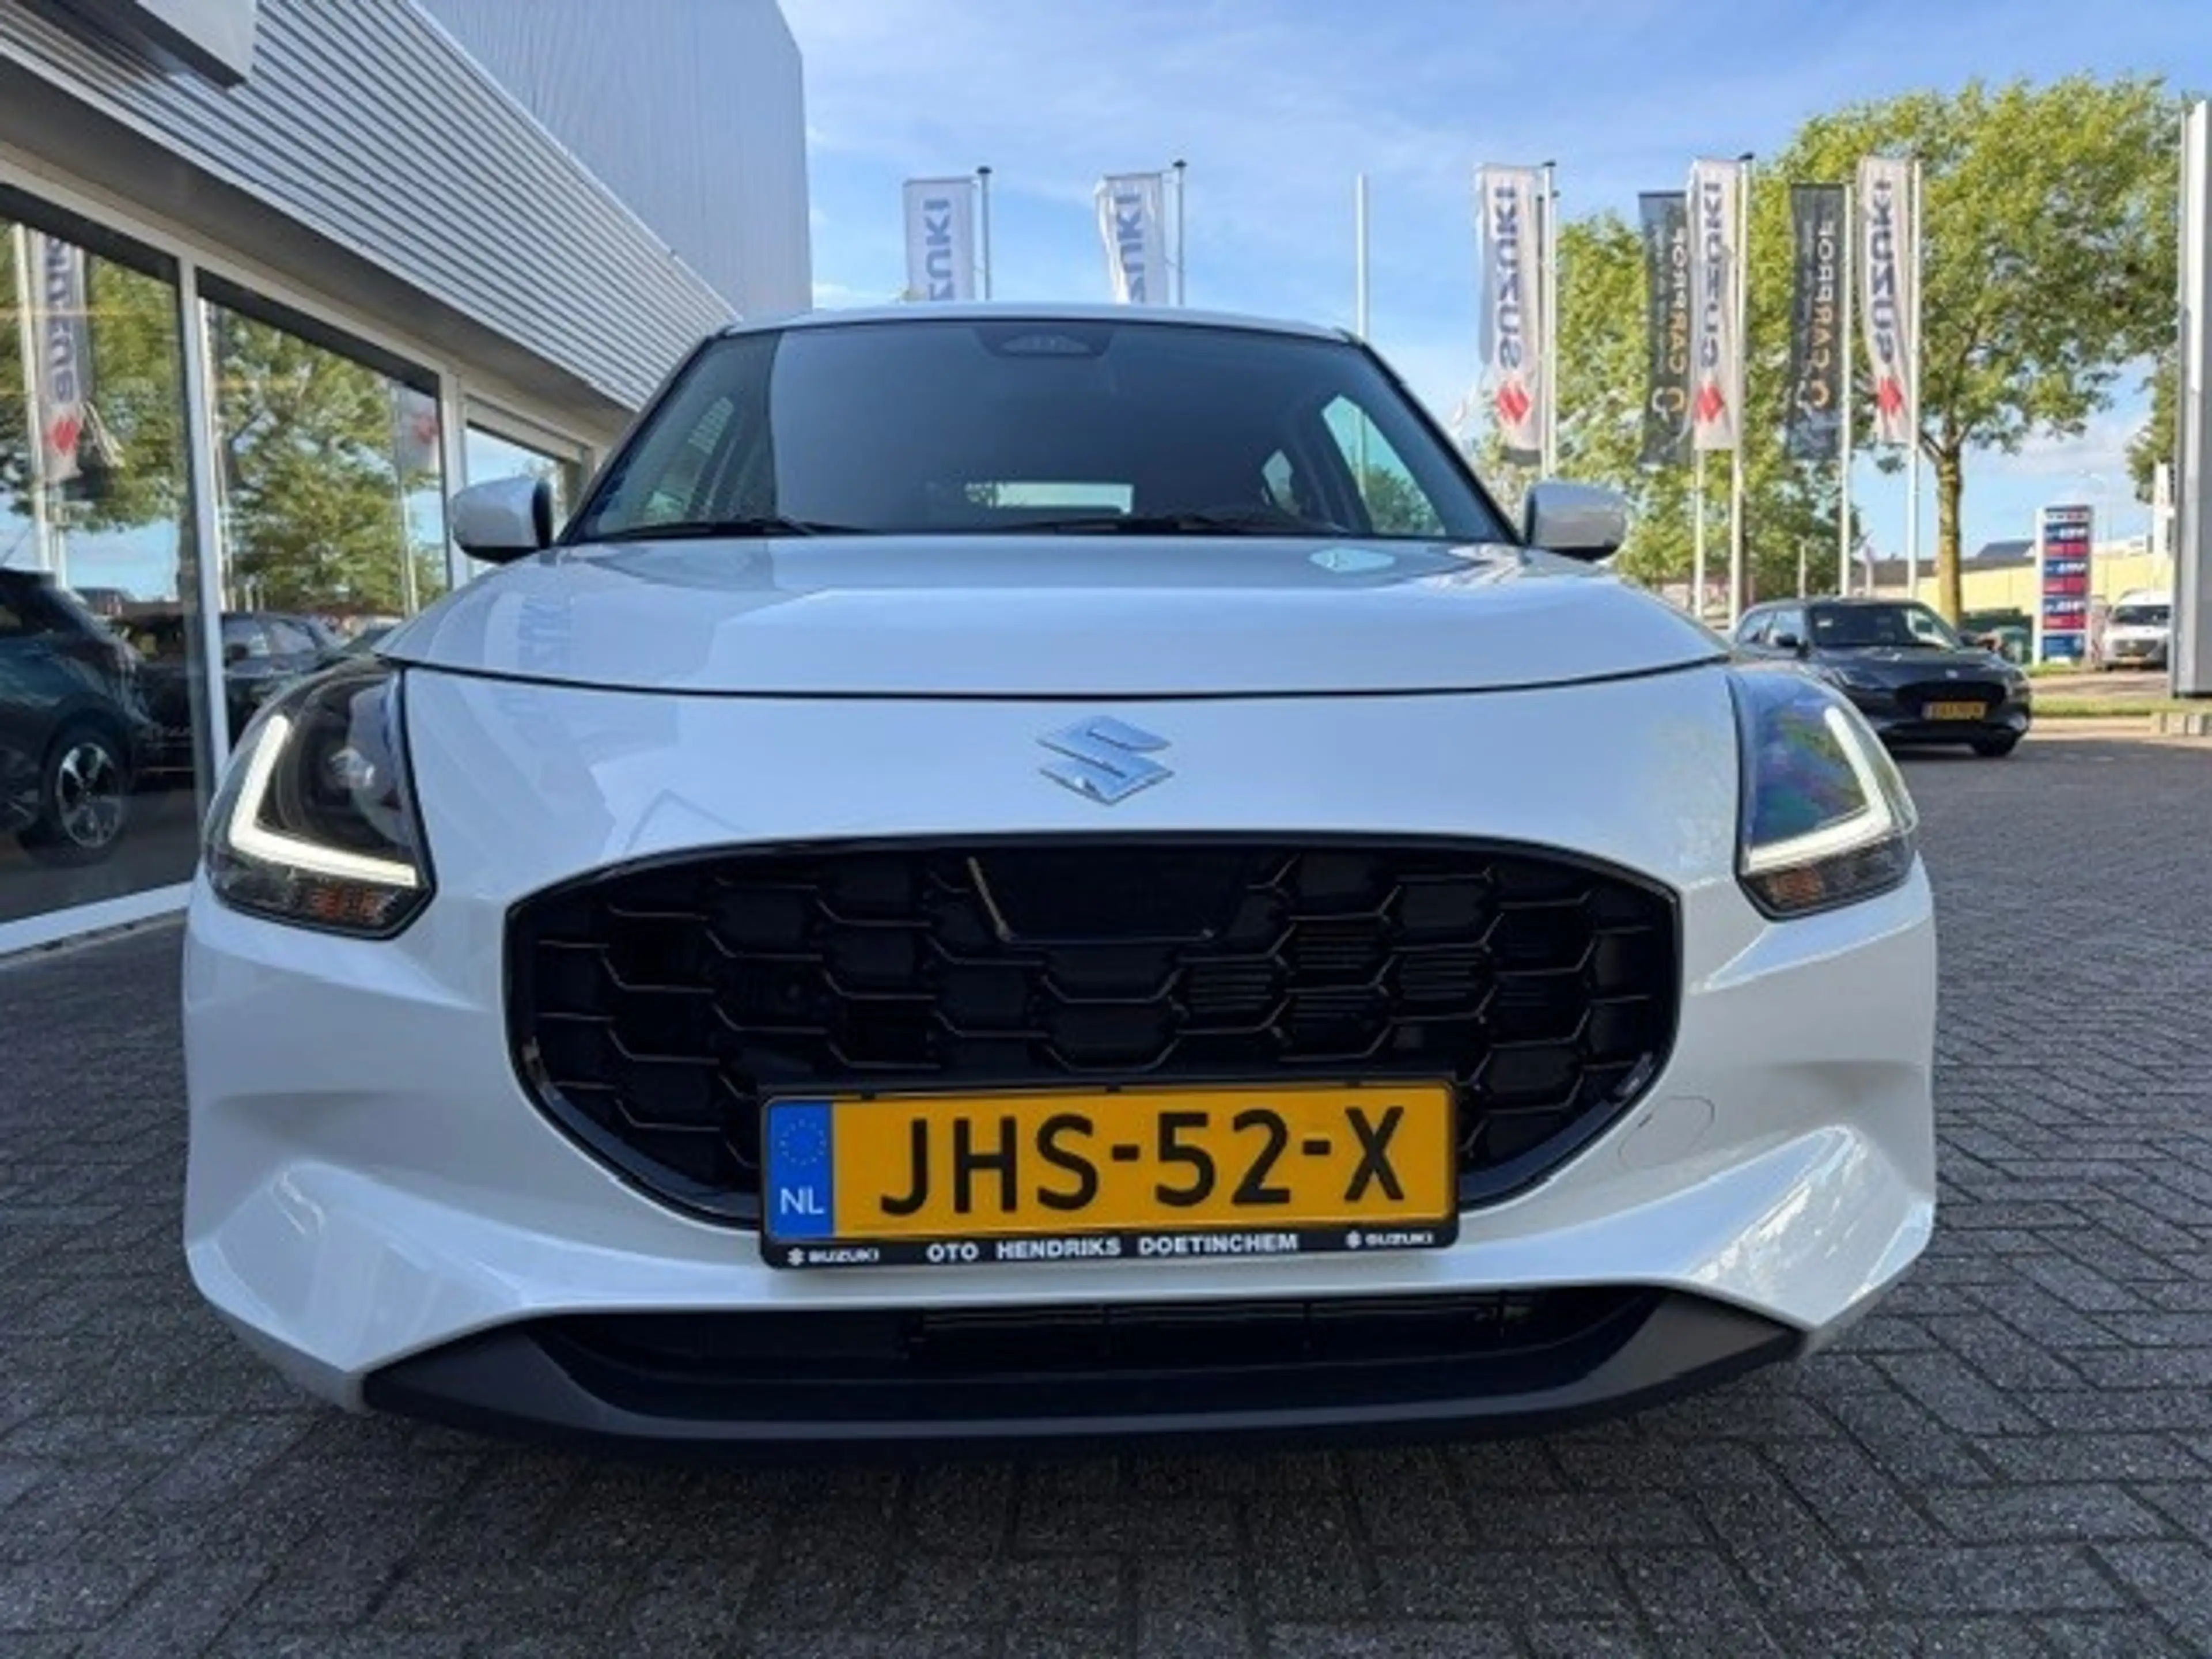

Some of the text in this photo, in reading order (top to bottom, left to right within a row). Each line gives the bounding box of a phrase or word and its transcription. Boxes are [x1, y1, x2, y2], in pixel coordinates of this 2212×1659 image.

[880, 1105, 1406, 1217] JHS-52-X
[781, 1186, 824, 1214] NL
[808, 1232, 1434, 1263] SUZUKI OTO HENDRIKS DOETINCHEM SUZUKI
